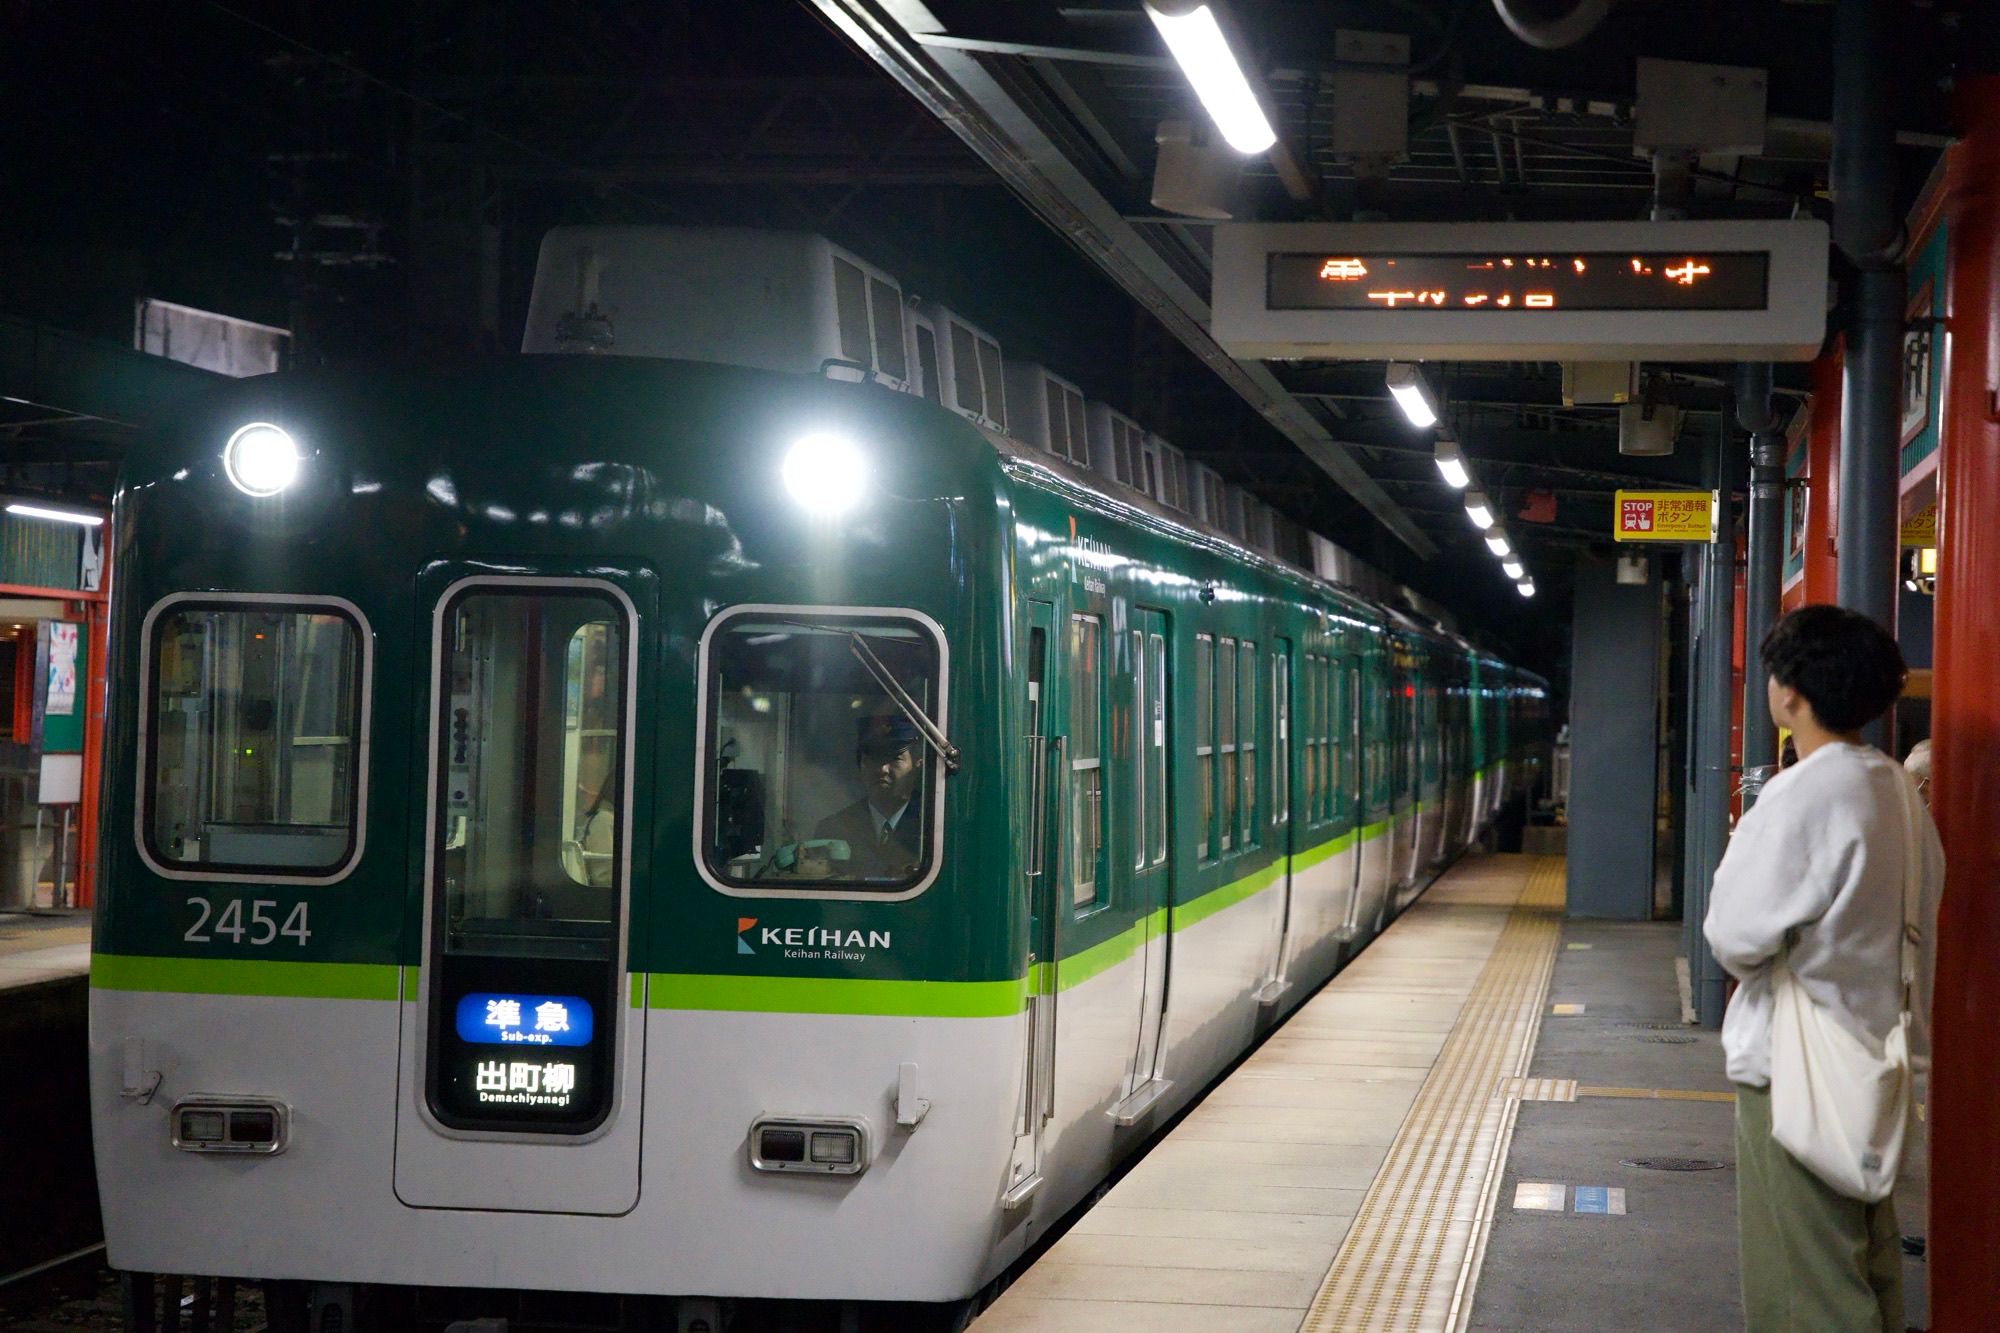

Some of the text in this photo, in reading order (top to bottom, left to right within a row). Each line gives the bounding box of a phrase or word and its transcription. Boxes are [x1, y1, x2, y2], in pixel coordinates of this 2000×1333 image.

[1623, 502, 1652, 511] STOP
[1657, 500, 1706, 511] 非常通報
[1657, 512, 1692, 523] ボタン
[184, 897, 312, 946] 2454
[762, 926, 891, 949] KEIHAN
[784, 949, 866, 962] Keihan Railway
[485, 999, 570, 1031] 準急
[501, 1031, 553, 1045] Sub-exp.
[476, 1060, 575, 1093] 出町柳
[479, 1092, 570, 1106] Demachiyanagi
